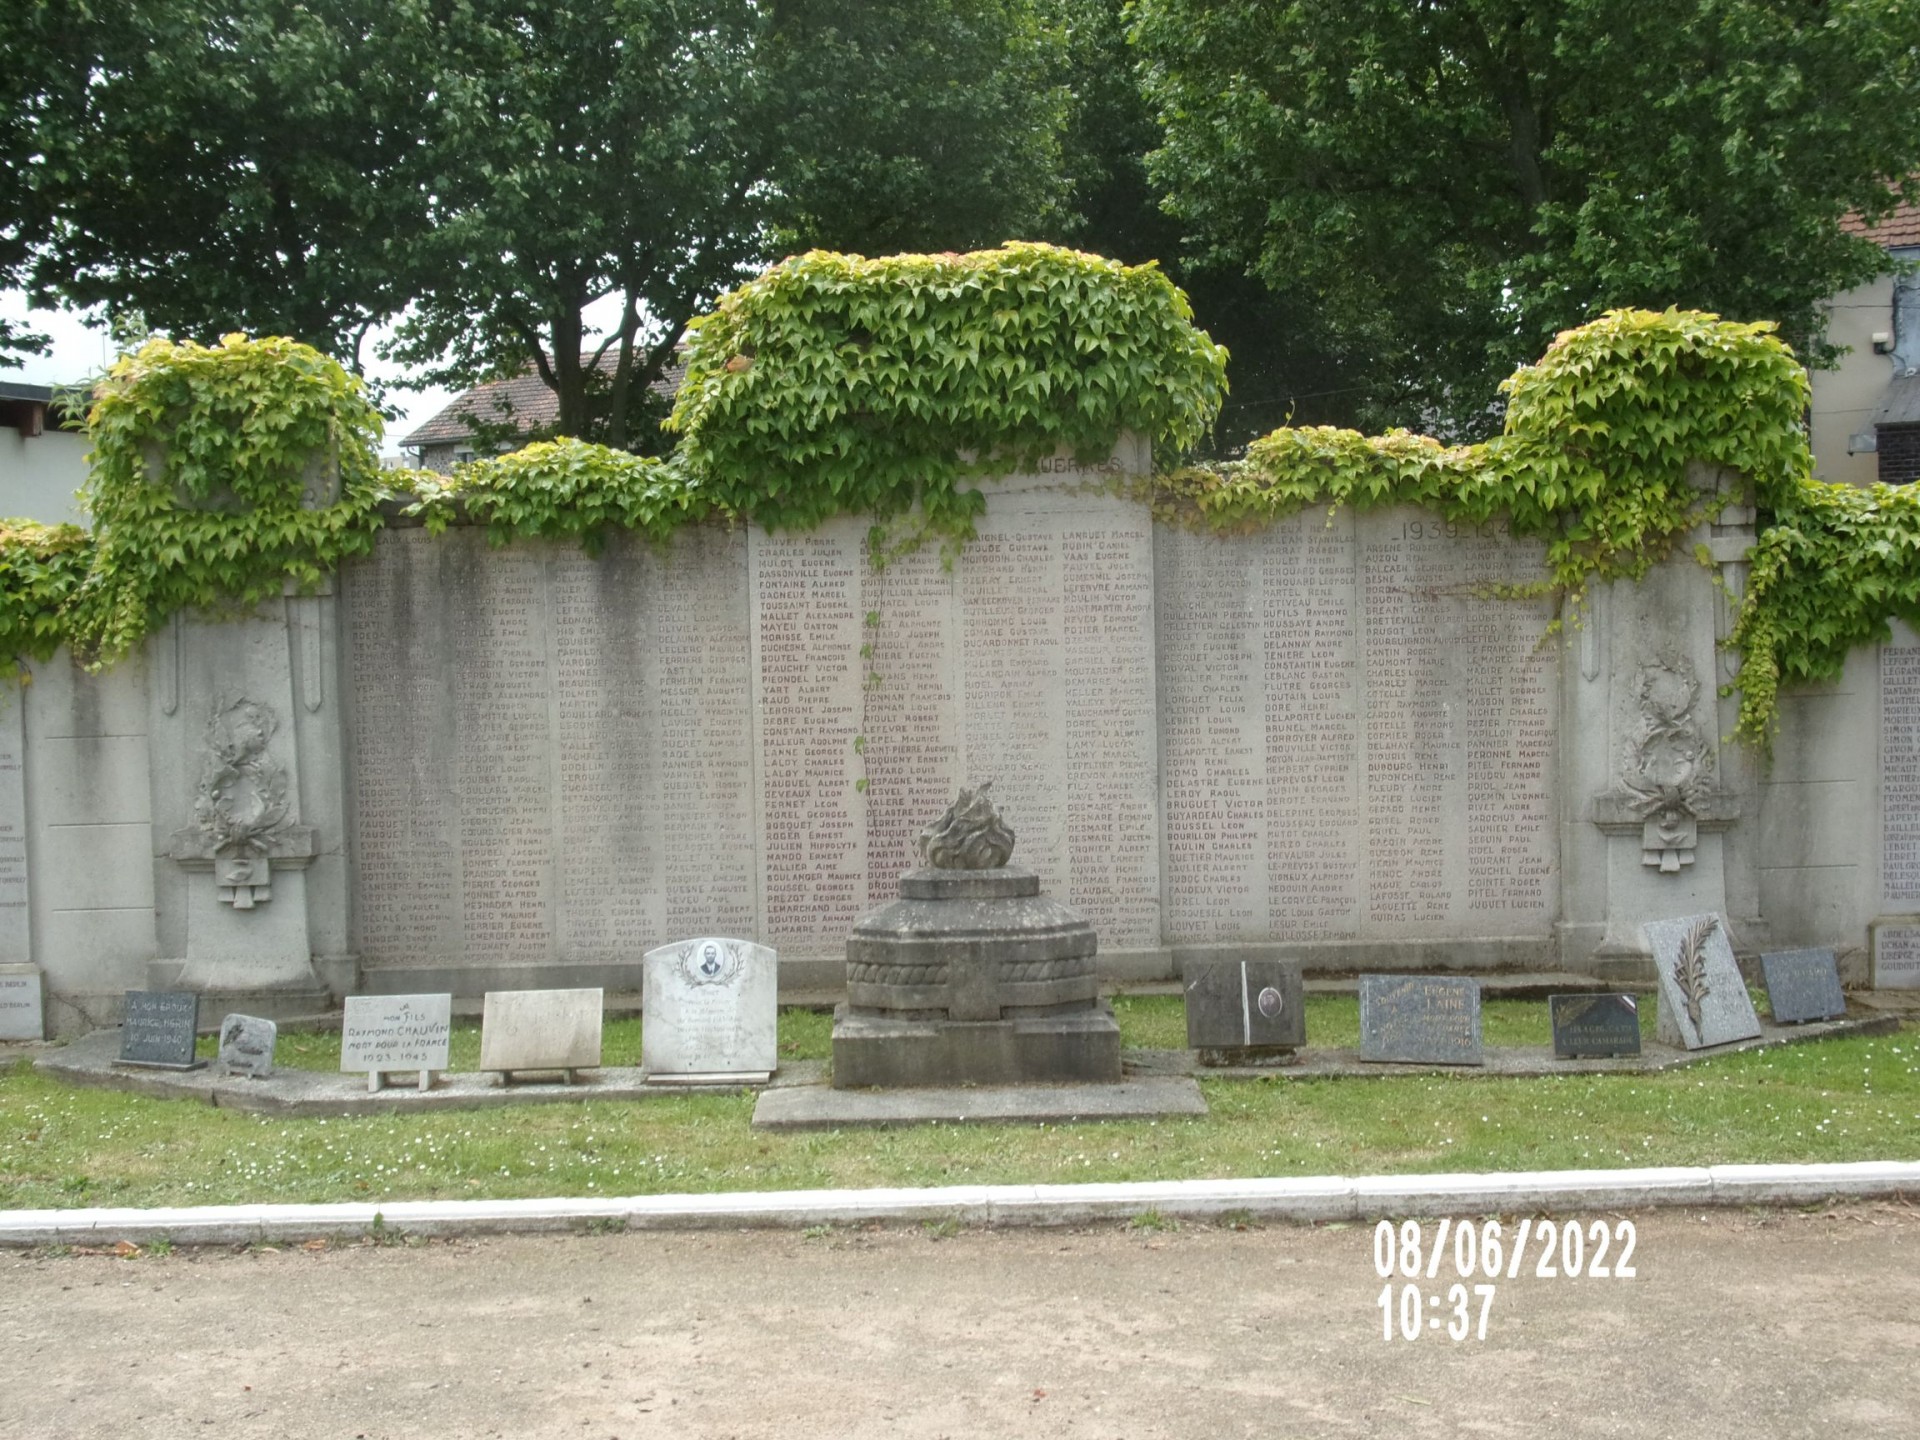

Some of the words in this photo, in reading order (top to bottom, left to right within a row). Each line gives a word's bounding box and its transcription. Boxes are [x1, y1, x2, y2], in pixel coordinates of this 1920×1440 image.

[1036, 456, 1122, 474] UERRES
[1264, 610, 1298, 618] DUFILS
[1366, 606, 1404, 615] BREANT
[761, 623, 796, 631] MAYEU
[1064, 626, 1098, 634] POTIER
[1034, 638, 1059, 646] RAOUL
[1265, 672, 1306, 680] LEBLANC
[763, 686, 788, 694] YART
[1265, 682, 1301, 690] FLUTRE
[661, 687, 699, 695] MESSIER
[1166, 696, 1209, 704] LONGUET
[764, 728, 813, 736] CONSTANT
[1883, 726, 1912, 734] SIMON
[1519, 750, 1550, 758] MARCEL
[663, 760, 702, 768] PANNIER
[1207, 768, 1250, 776] CHARLES
[1167, 790, 1201, 798] LEROY
[1167, 801, 1217, 809] BRUGUET
[1226, 800, 1263, 808] VICTOR
[1515, 824, 1540, 832] EMILE
[1168, 843, 1205, 851] TAULIN
[1070, 866, 1108, 874] AUVRAY
[768, 874, 822, 882] BOULANGER
[463, 880, 495, 888] PIERRE
[464, 891, 500, 899] MONNET
[1371, 892, 1410, 900] LAFOSSE
[1469, 889, 1498, 897] PITEL
[1502, 888, 1541, 896] FERNAND
[667, 896, 698, 904] NEVEU
[768, 905, 829, 913] LEMARCHAND
[1170, 922, 1206, 930] LOUVET
[1216, 922, 1240, 930] LOUIS
[465, 932, 516, 940] LEMERCIER
[349, 1028, 393, 1036] RAYMOND
[397, 1022, 448, 1036] CHAUVIN
